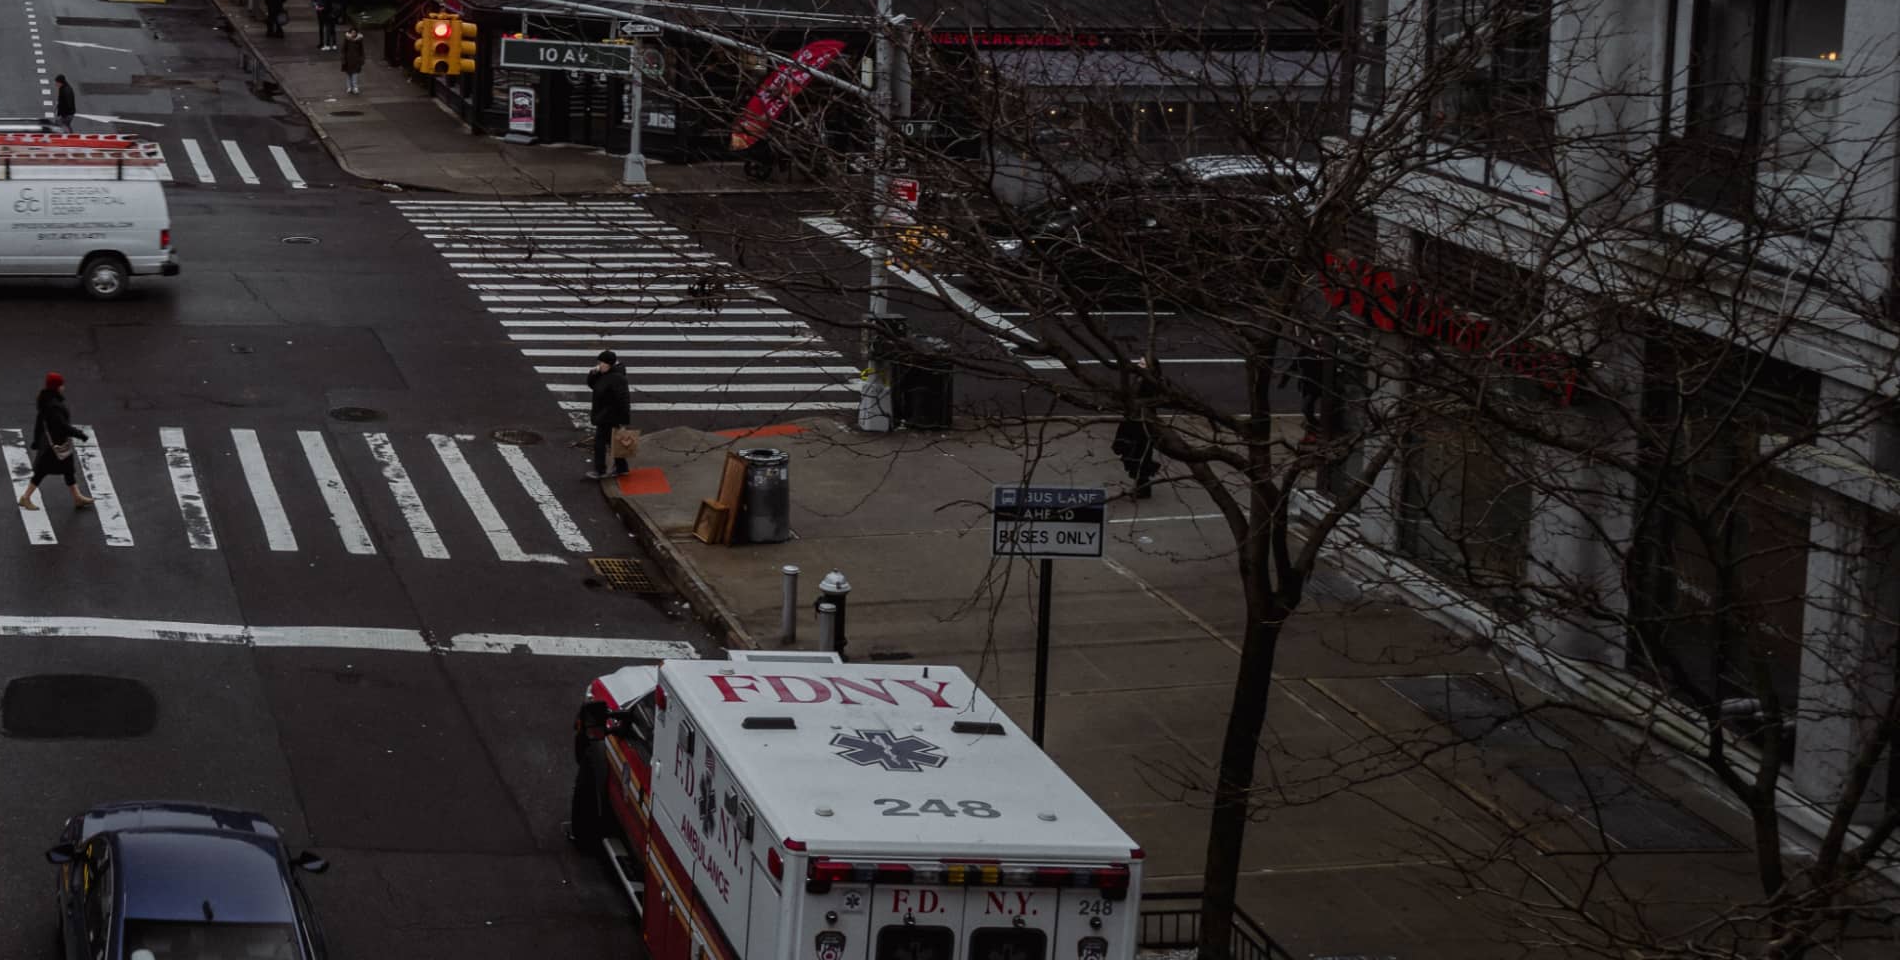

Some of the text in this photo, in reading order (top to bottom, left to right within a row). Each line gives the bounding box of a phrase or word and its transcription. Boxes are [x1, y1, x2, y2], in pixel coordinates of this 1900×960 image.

[538, 47, 559, 63] 10
[1026, 491, 1101, 505] BUS LANE
[1023, 508, 1076, 521] AHED
[999, 530, 1096, 545] BUSES ONLY
[707, 675, 959, 709] FDNY
[874, 798, 1002, 819] 248
[681, 814, 730, 905] AMBULANCE
[891, 889, 1038, 916] F.D. N.Y.
[1079, 899, 1113, 917] 248
